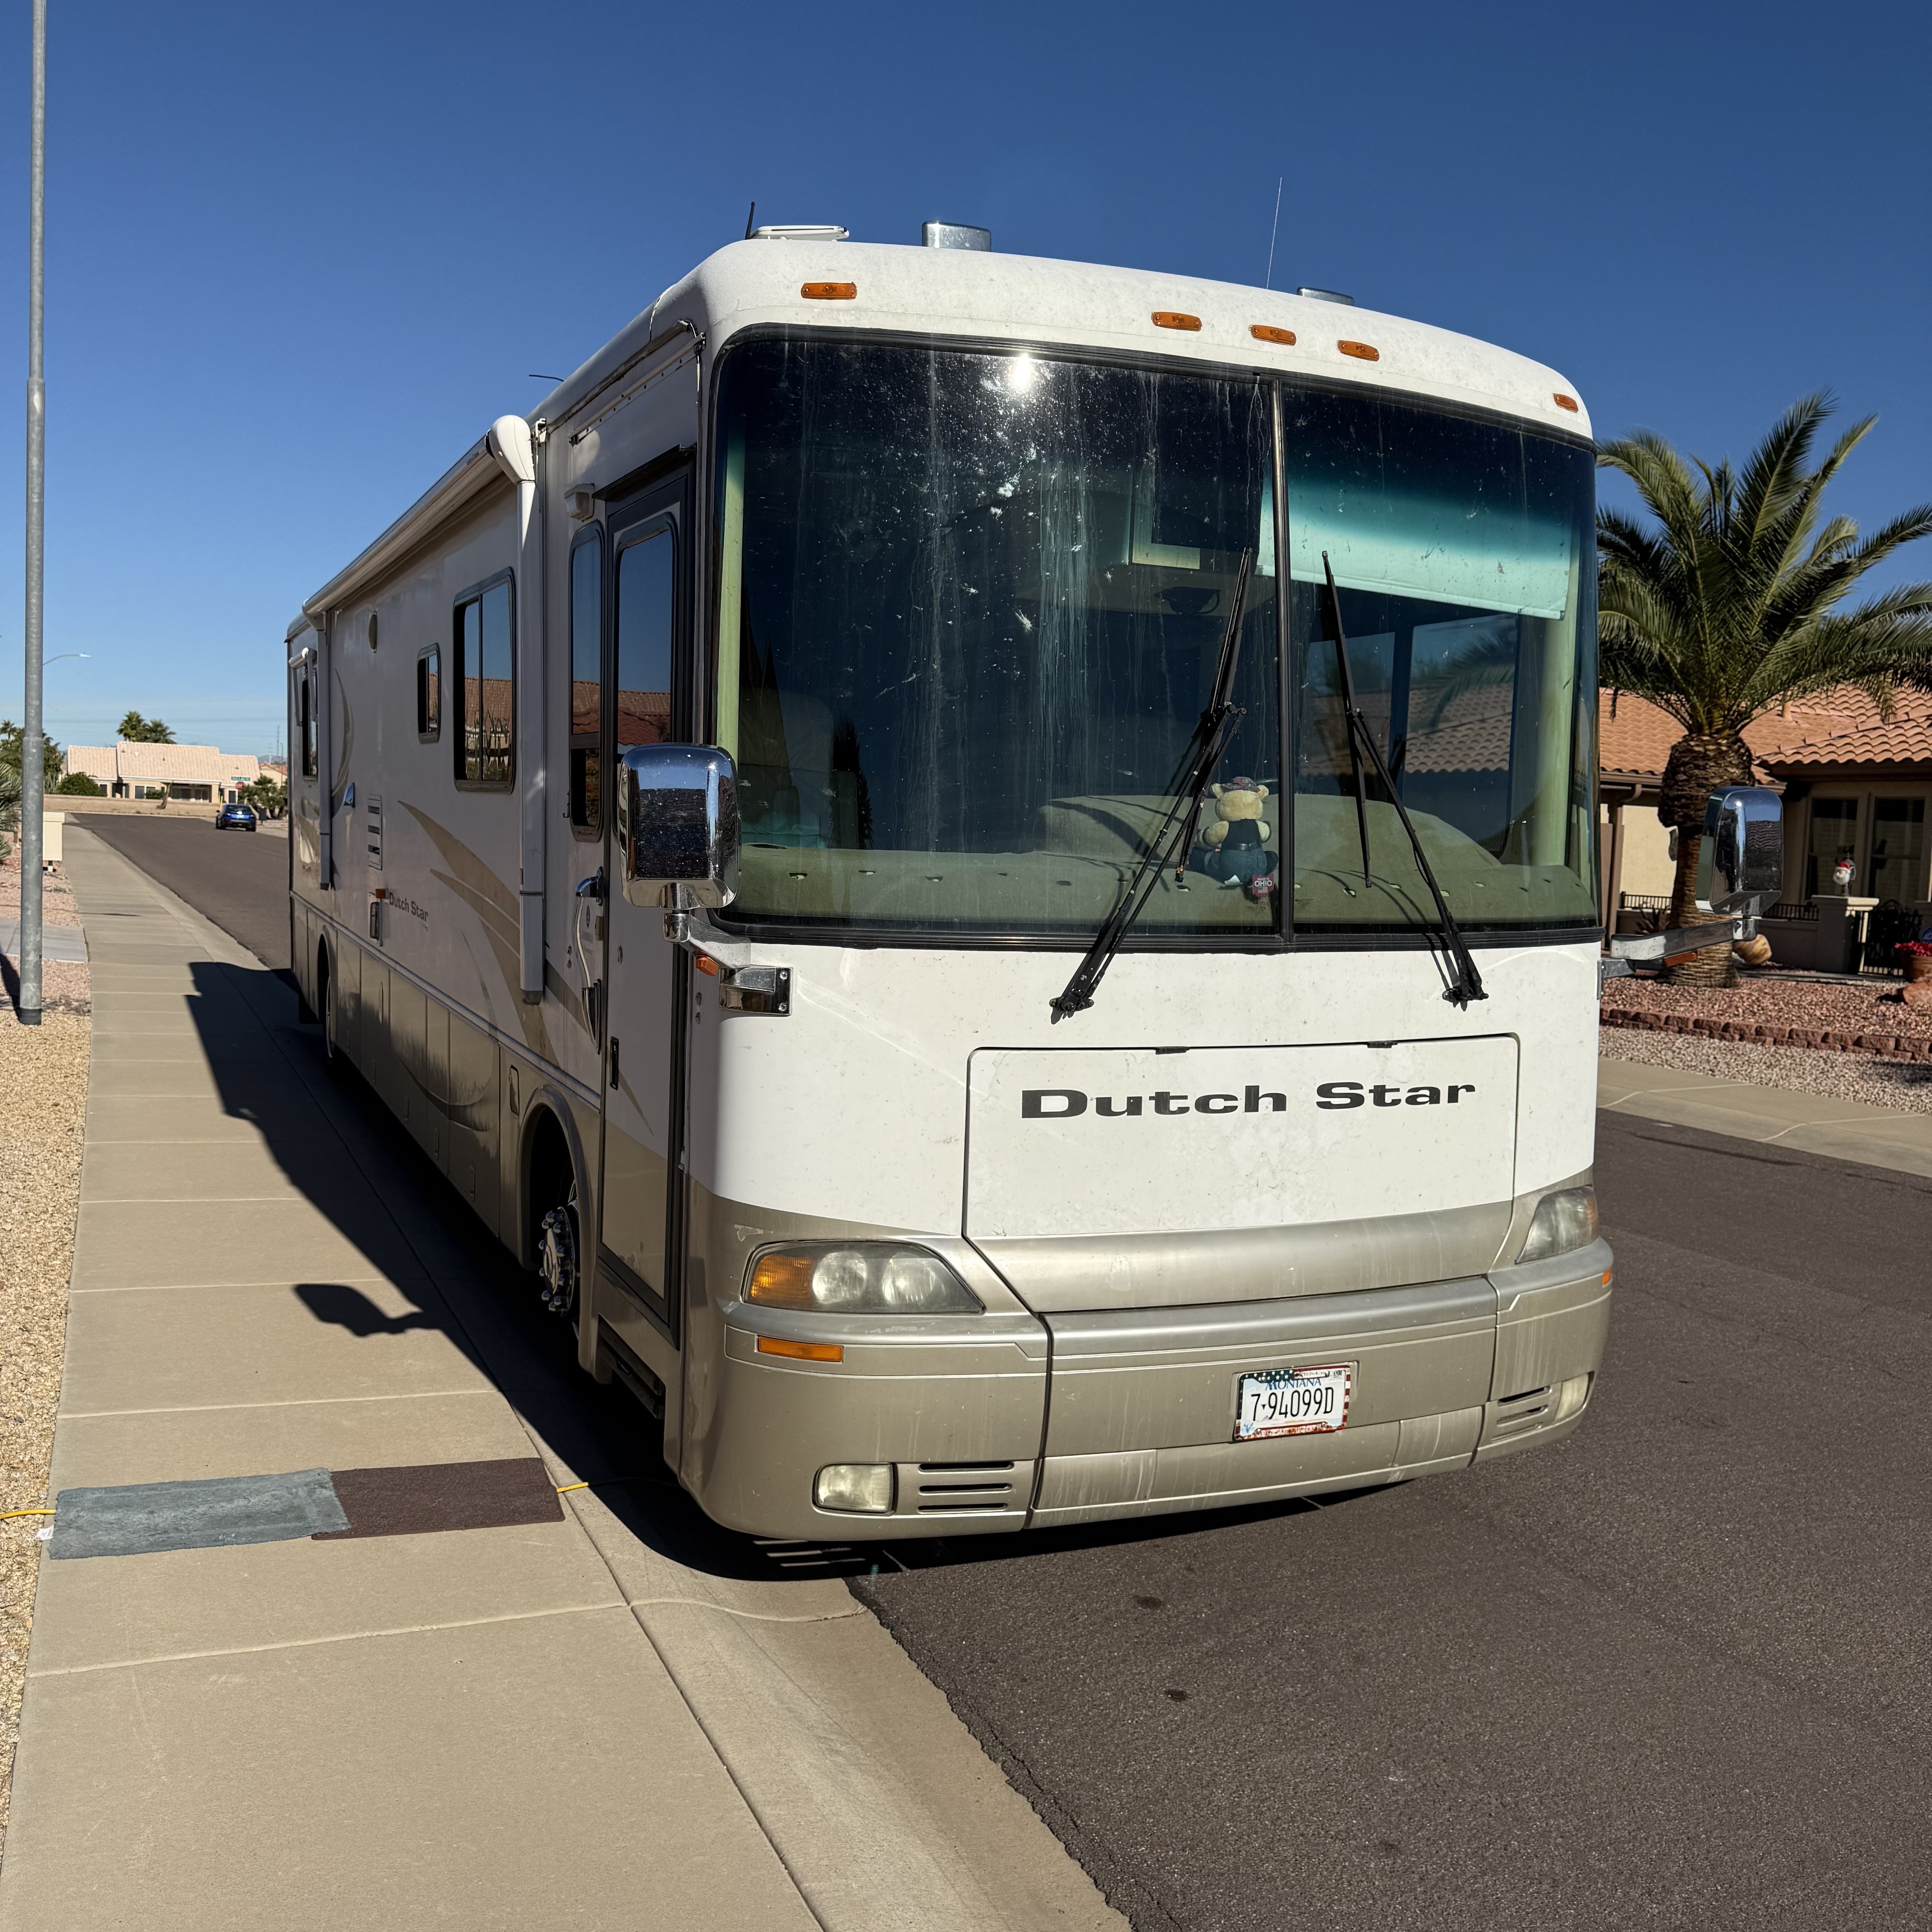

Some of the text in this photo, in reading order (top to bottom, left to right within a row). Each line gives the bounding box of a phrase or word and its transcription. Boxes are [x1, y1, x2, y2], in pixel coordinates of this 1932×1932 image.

[389, 891, 428, 922] Dutch Star
[1021, 1081, 1476, 1118] Dutch Star
[1265, 1378, 1321, 1391] MONTANA
